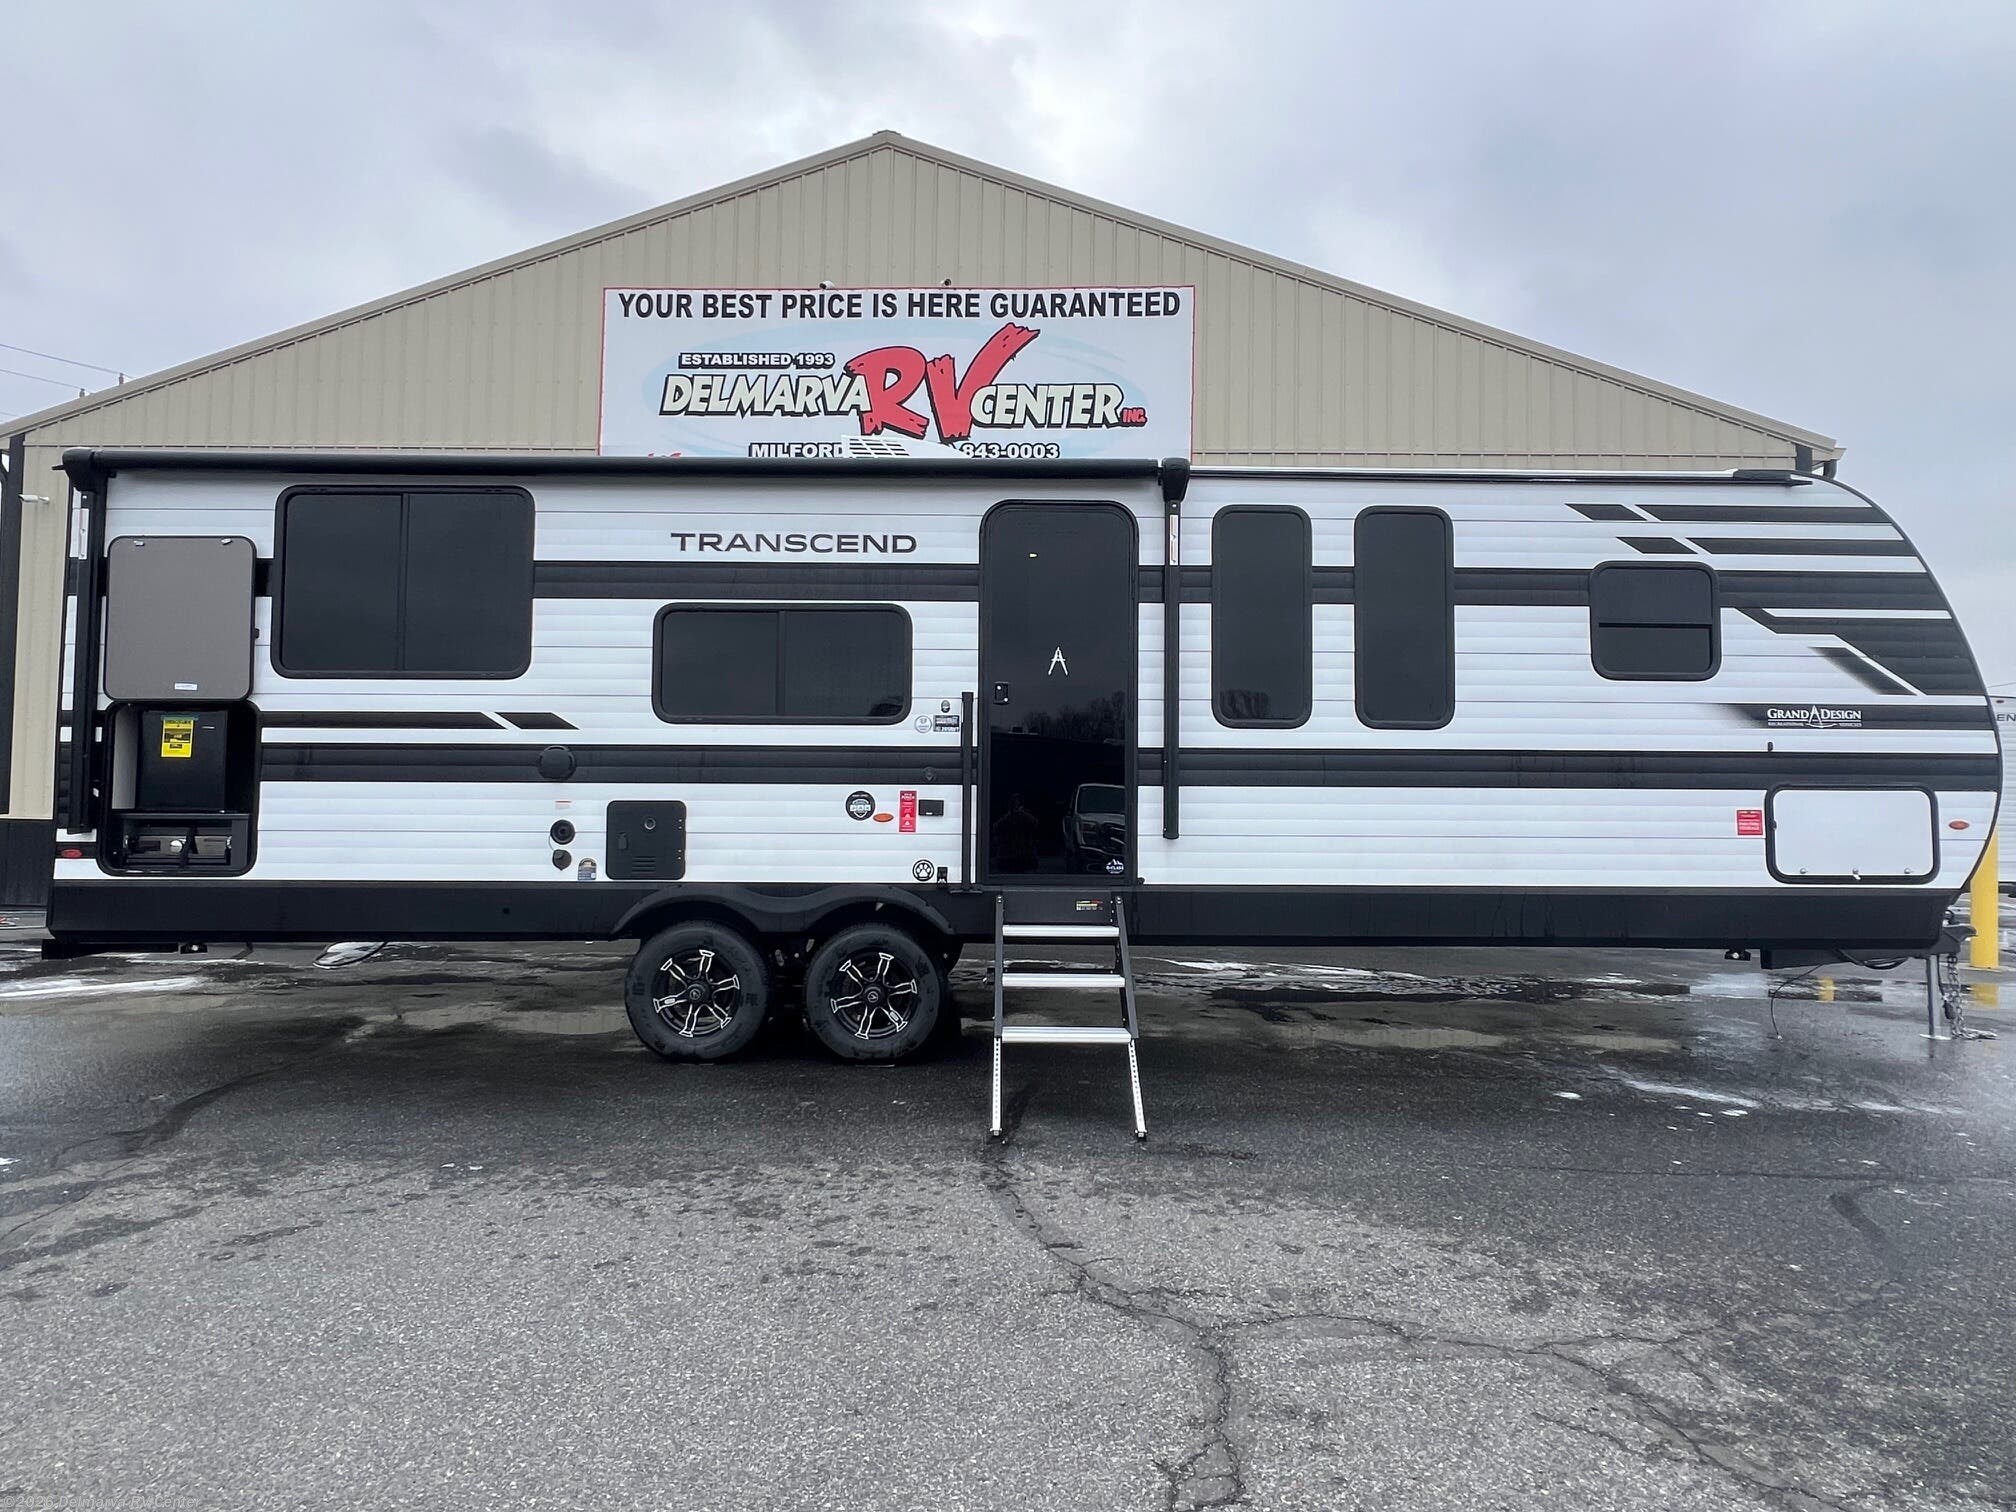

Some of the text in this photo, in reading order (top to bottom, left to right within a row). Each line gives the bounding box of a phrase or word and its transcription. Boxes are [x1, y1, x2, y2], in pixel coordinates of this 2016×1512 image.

[618, 291, 1181, 319] YOUR BEST PRICE IS HERE GUARANTEED
[680, 352, 835, 369] ESTABLISHED 1993
[660, 374, 872, 417] DELMARVA
[844, 322, 1040, 443] RV
[970, 383, 1124, 428] CENTER
[670, 532, 917, 554] TRANSCEND
[1767, 708, 1862, 720] GRAND DESIGN
